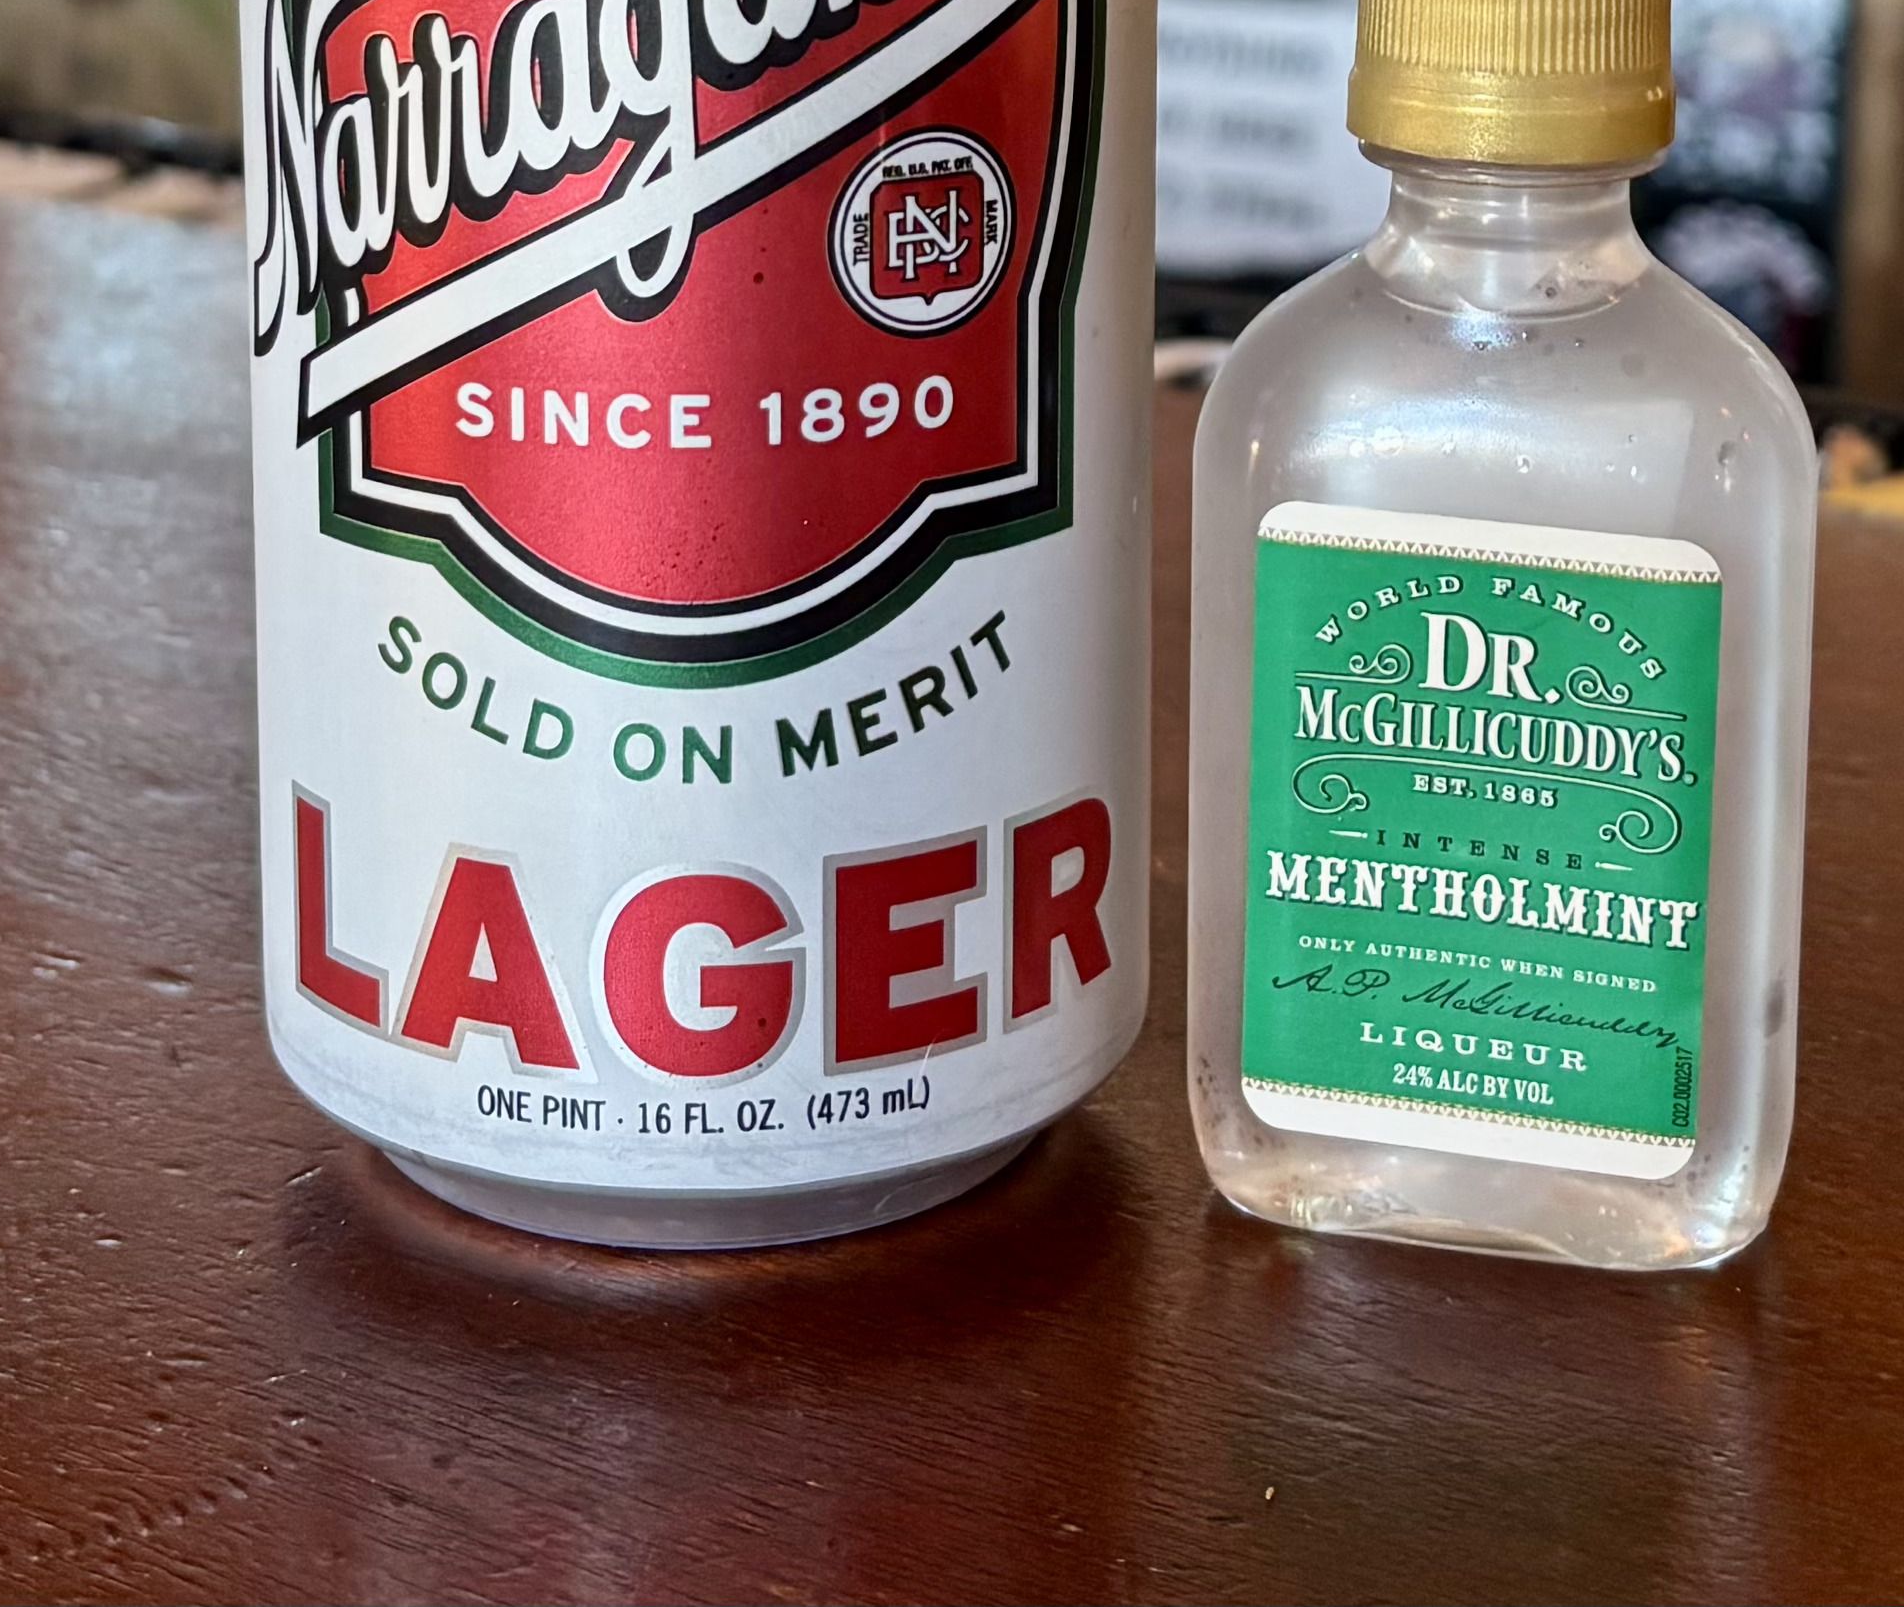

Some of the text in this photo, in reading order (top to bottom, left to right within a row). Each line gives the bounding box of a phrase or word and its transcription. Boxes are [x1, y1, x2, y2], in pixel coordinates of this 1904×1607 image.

[853, 212, 870, 267] TRADE
[985, 199, 998, 246] MARK
[456, 374, 955, 449] SINCE 1890
[1314, 575, 1666, 680] WORLD FAMOUS
[1418, 611, 1562, 705] DR.
[377, 609, 1013, 785] SOLD ON MERIT
[1484, 782, 1558, 808] 1865
[1376, 829, 1583, 870] INTENSE
[1265, 850, 1699, 950] MENTHOLMINT
[293, 782, 1114, 1084] LAGER
[1298, 934, 1657, 993] ONLY AUTHENTIC WHEN SIGNED
[1359, 1021, 1588, 1073] LIQUEUR
[478, 1075, 931, 1135] ONE PINT 16 FL. OZ. (473 mL)
[1393, 1062, 1554, 1106] 24% ALC BY VOL
